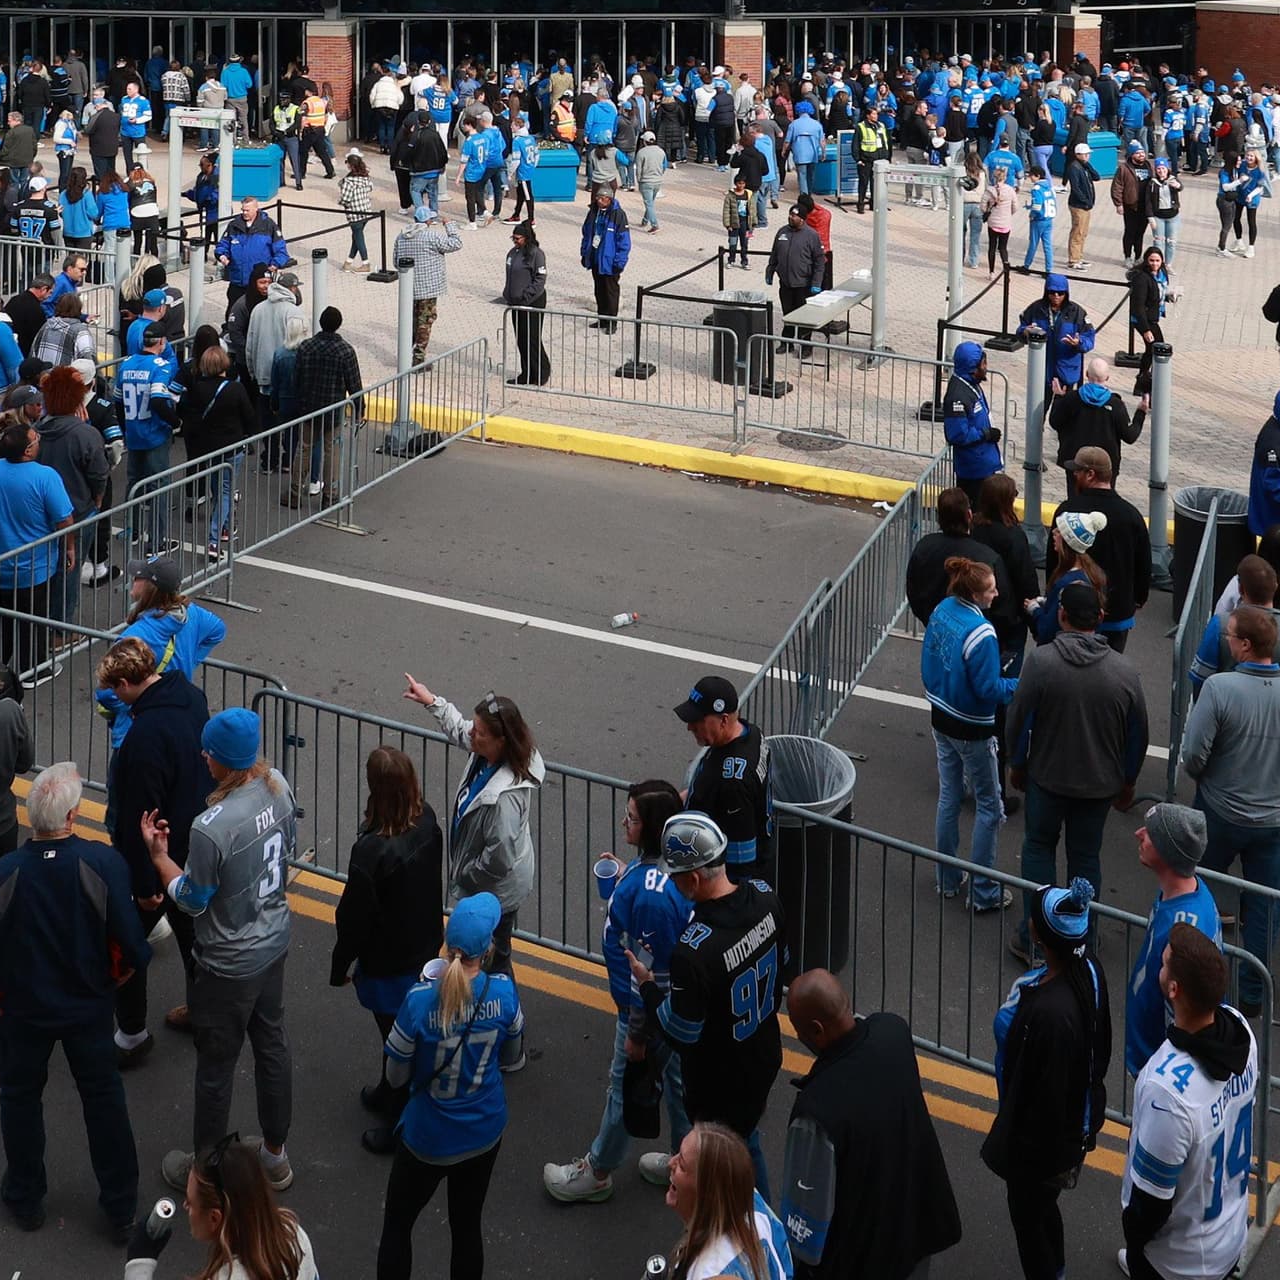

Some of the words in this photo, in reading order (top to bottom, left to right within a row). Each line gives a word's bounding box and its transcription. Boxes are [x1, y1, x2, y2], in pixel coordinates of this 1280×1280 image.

[20, 216, 45, 240] 97
[121, 381, 151, 421] 97
[722, 756, 747, 780] 97
[200, 805, 224, 826] 3
[255, 806, 277, 836] FOX
[257, 827, 285, 899] 3
[645, 868, 669, 893] 87
[679, 922, 712, 951] 97
[723, 913, 776, 973] HUTCHINSON
[730, 943, 778, 1043] 97
[429, 997, 501, 1031] HUHINSON
[429, 1029, 499, 1100] 97
[1155, 1052, 1195, 1094] 14
[1203, 1099, 1254, 1222] 14
